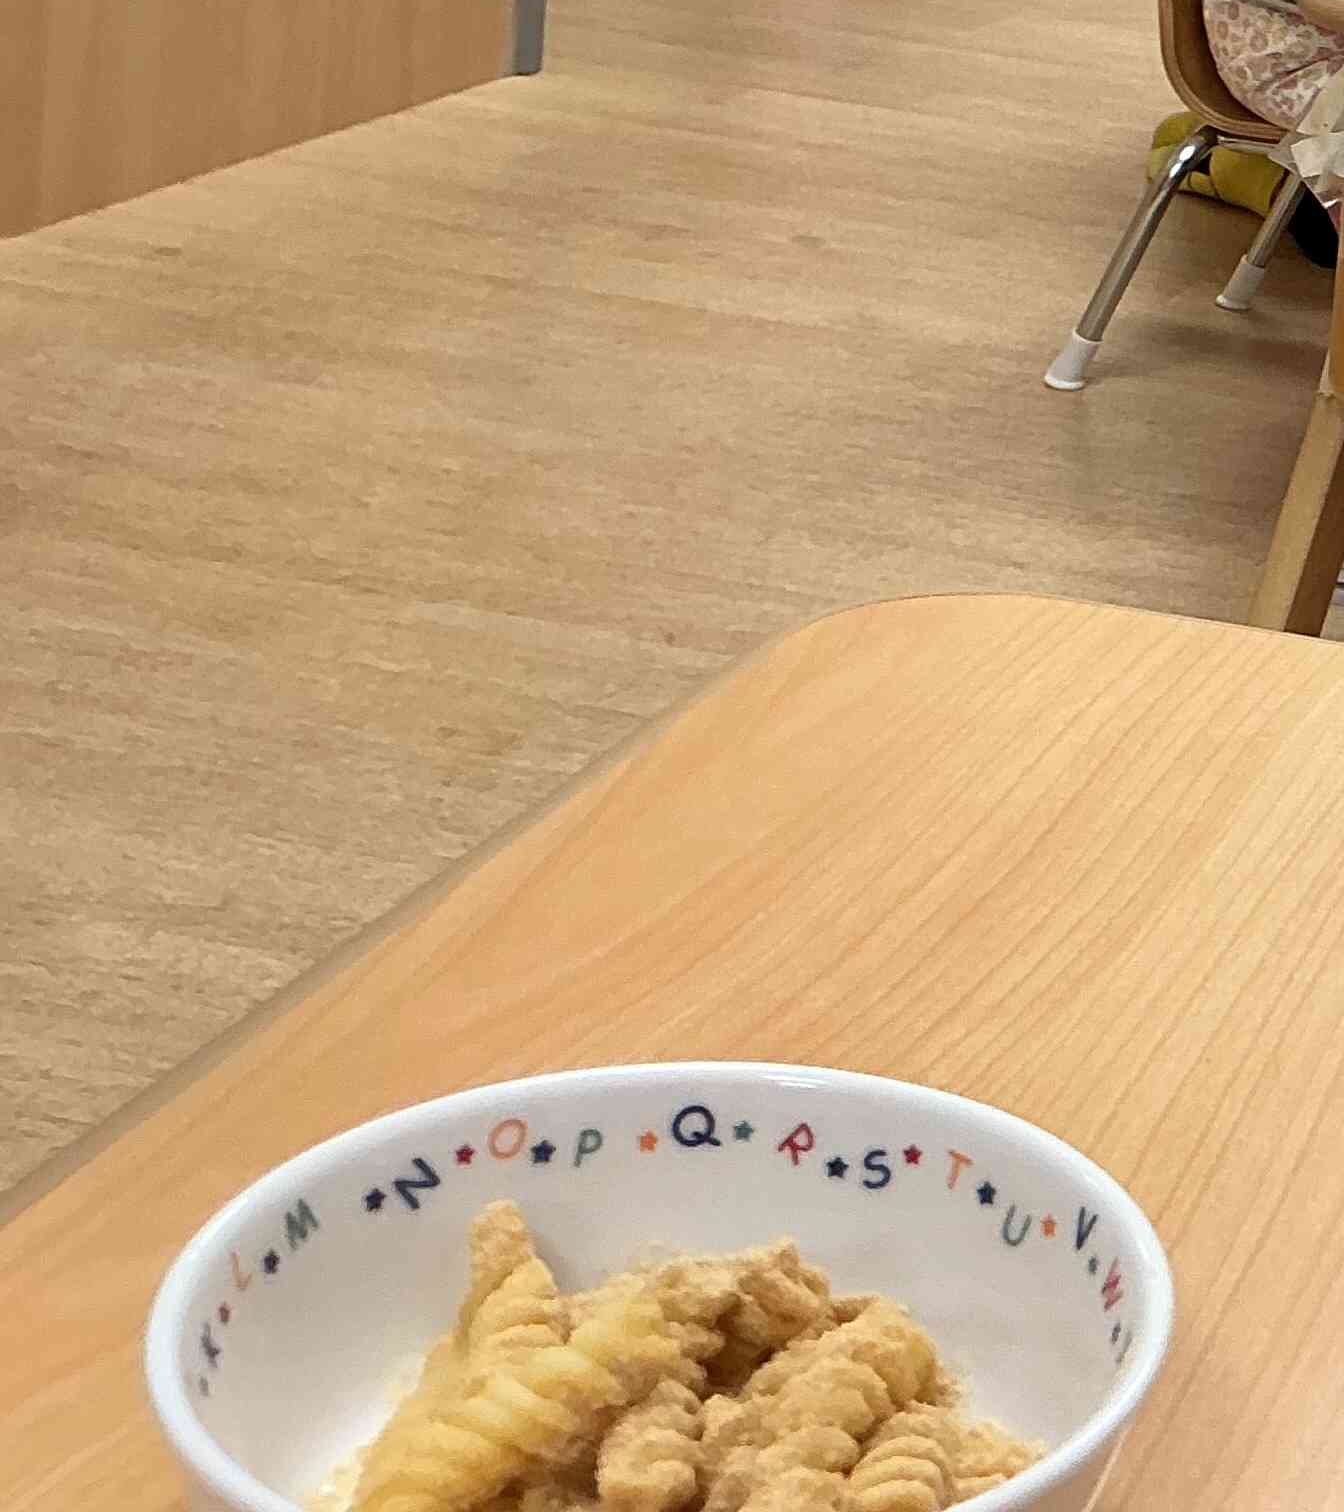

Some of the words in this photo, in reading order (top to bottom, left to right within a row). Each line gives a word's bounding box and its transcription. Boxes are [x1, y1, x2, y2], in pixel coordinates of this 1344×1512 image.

[284, 1198, 320, 1251] M
[392, 1157, 441, 1210] N
[487, 1118, 528, 1160] O
[572, 1127, 603, 1168] P
[672, 1104, 721, 1148] Q
[777, 1122, 815, 1166] R
[862, 1148, 892, 1189] S
[947, 1149, 974, 1190] T
[1002, 1204, 1033, 1247] U
[1075, 1206, 1099, 1251] V
